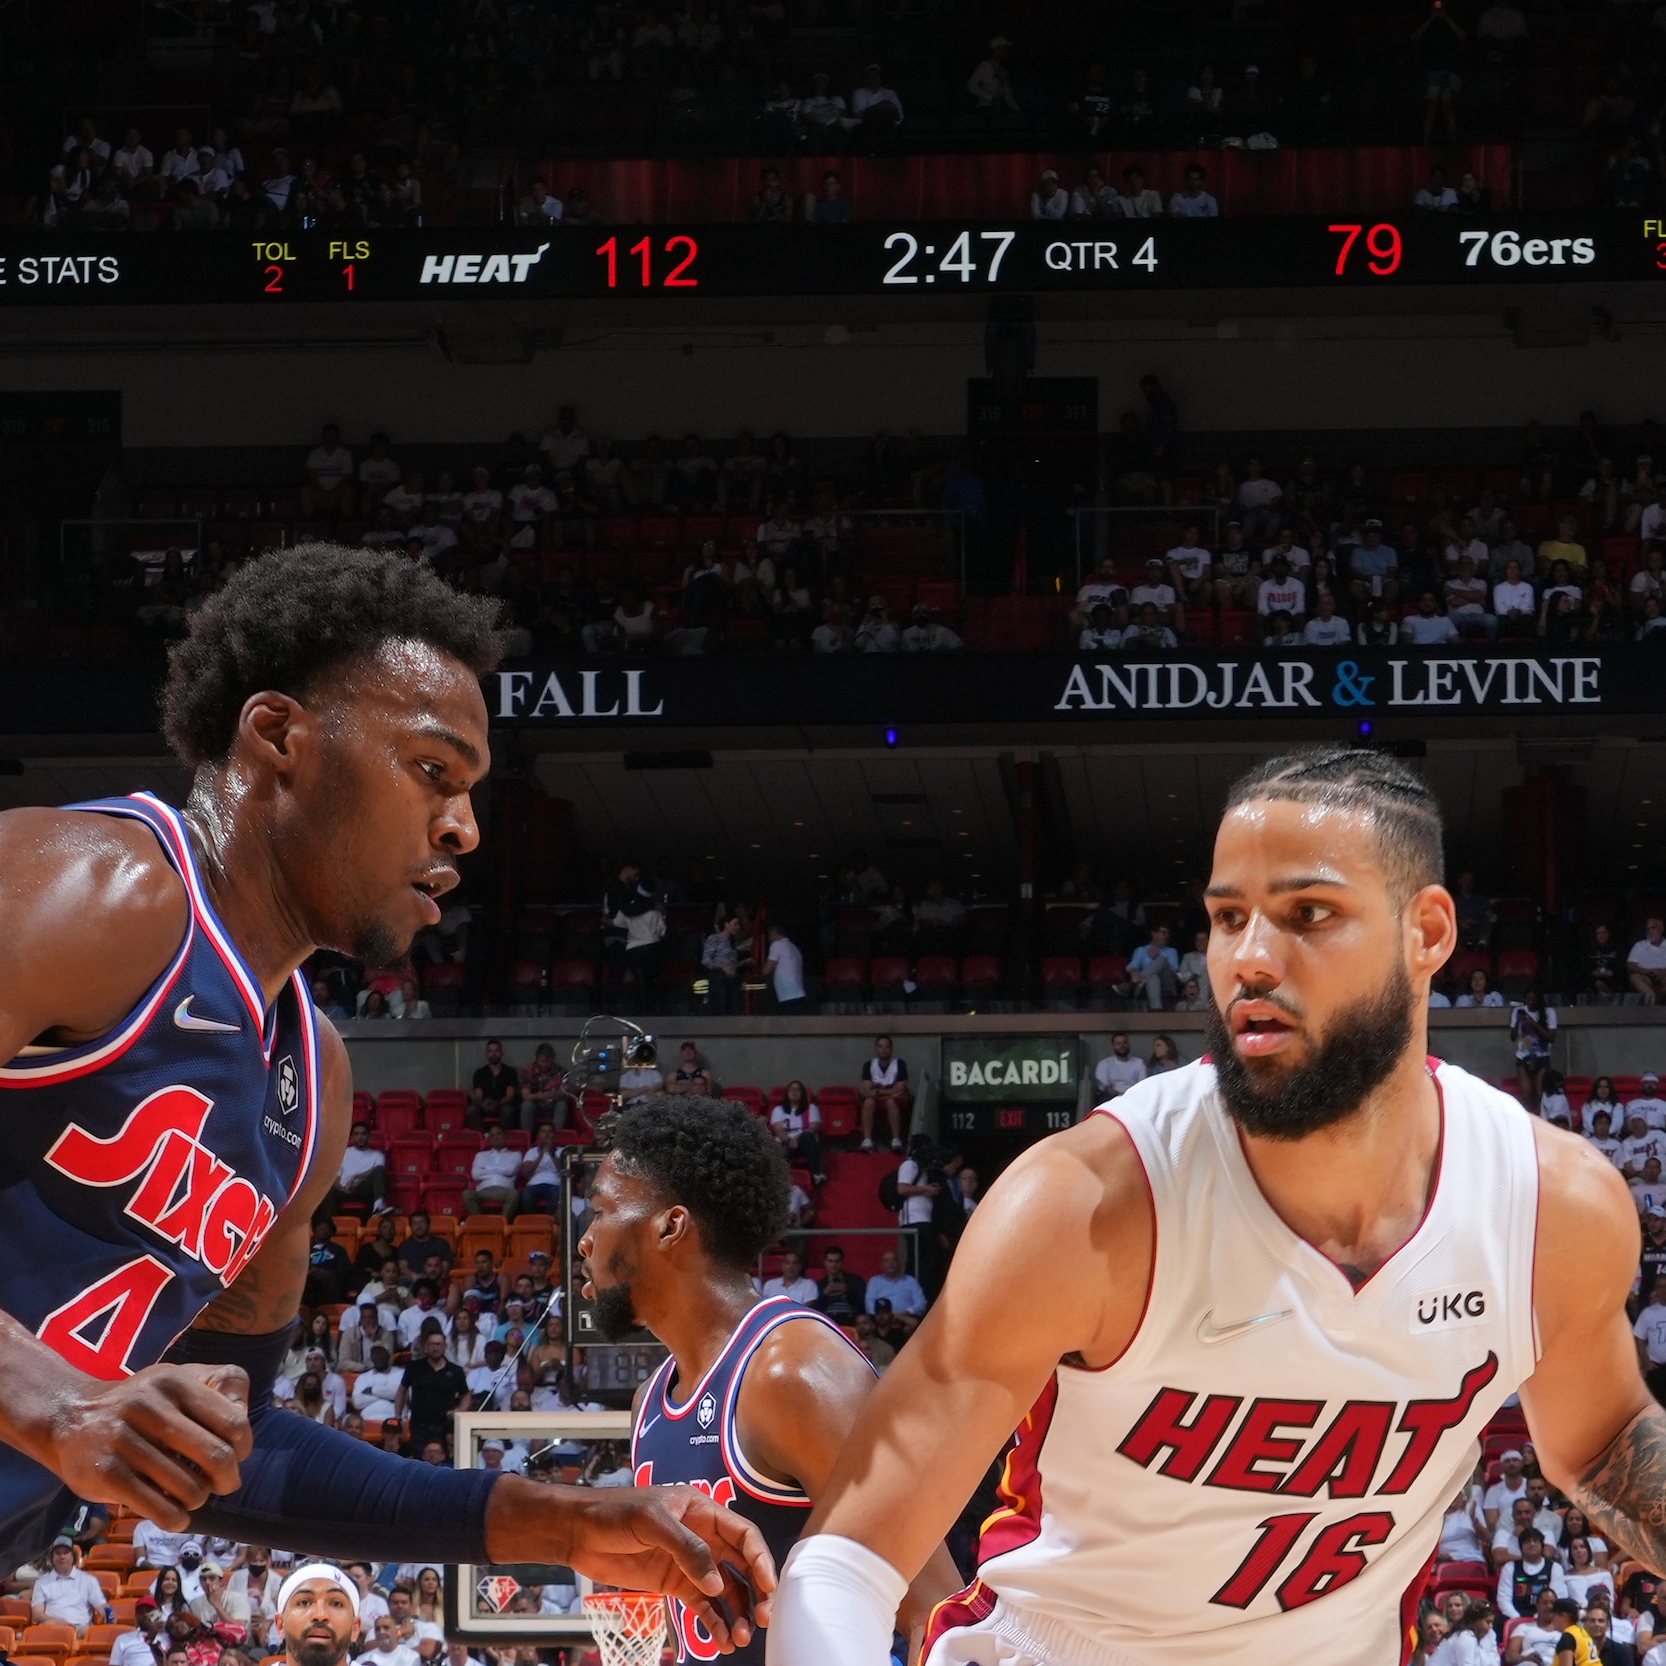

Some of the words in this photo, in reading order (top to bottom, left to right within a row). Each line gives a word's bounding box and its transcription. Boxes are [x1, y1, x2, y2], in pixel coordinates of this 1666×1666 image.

[252, 242, 297, 261] TOL
[328, 240, 370, 259] FLS
[420, 243, 550, 284] HEAT
[595, 235, 699, 288] 112
[883, 230, 1016, 284] 2:47
[1044, 241, 1118, 272] QTR
[1132, 236, 1158, 273] 4
[1328, 223, 1403, 276] 79
[1459, 230, 1596, 266] 76ers
[17, 256, 120, 284] STATS
[263, 264, 283, 293] 2
[342, 264, 354, 291] 1
[494, 669, 665, 719] FALL
[1055, 662, 1322, 710] ANIDJAR
[1332, 659, 1376, 707] &
[1387, 657, 1602, 706] LEVINE
[949, 1052, 1071, 1086] BACARDÍ
[951, 1112, 975, 1130] 112
[998, 1110, 1024, 1127] EXIT
[1045, 1110, 1071, 1129] 113
[37, 1254, 176, 1379] 4
[1417, 1290, 1486, 1325] UKG
[689, 1434, 721, 1446] crypto.com
[1116, 1350, 1499, 1499] HEAT
[1209, 1510, 1396, 1611] 16
